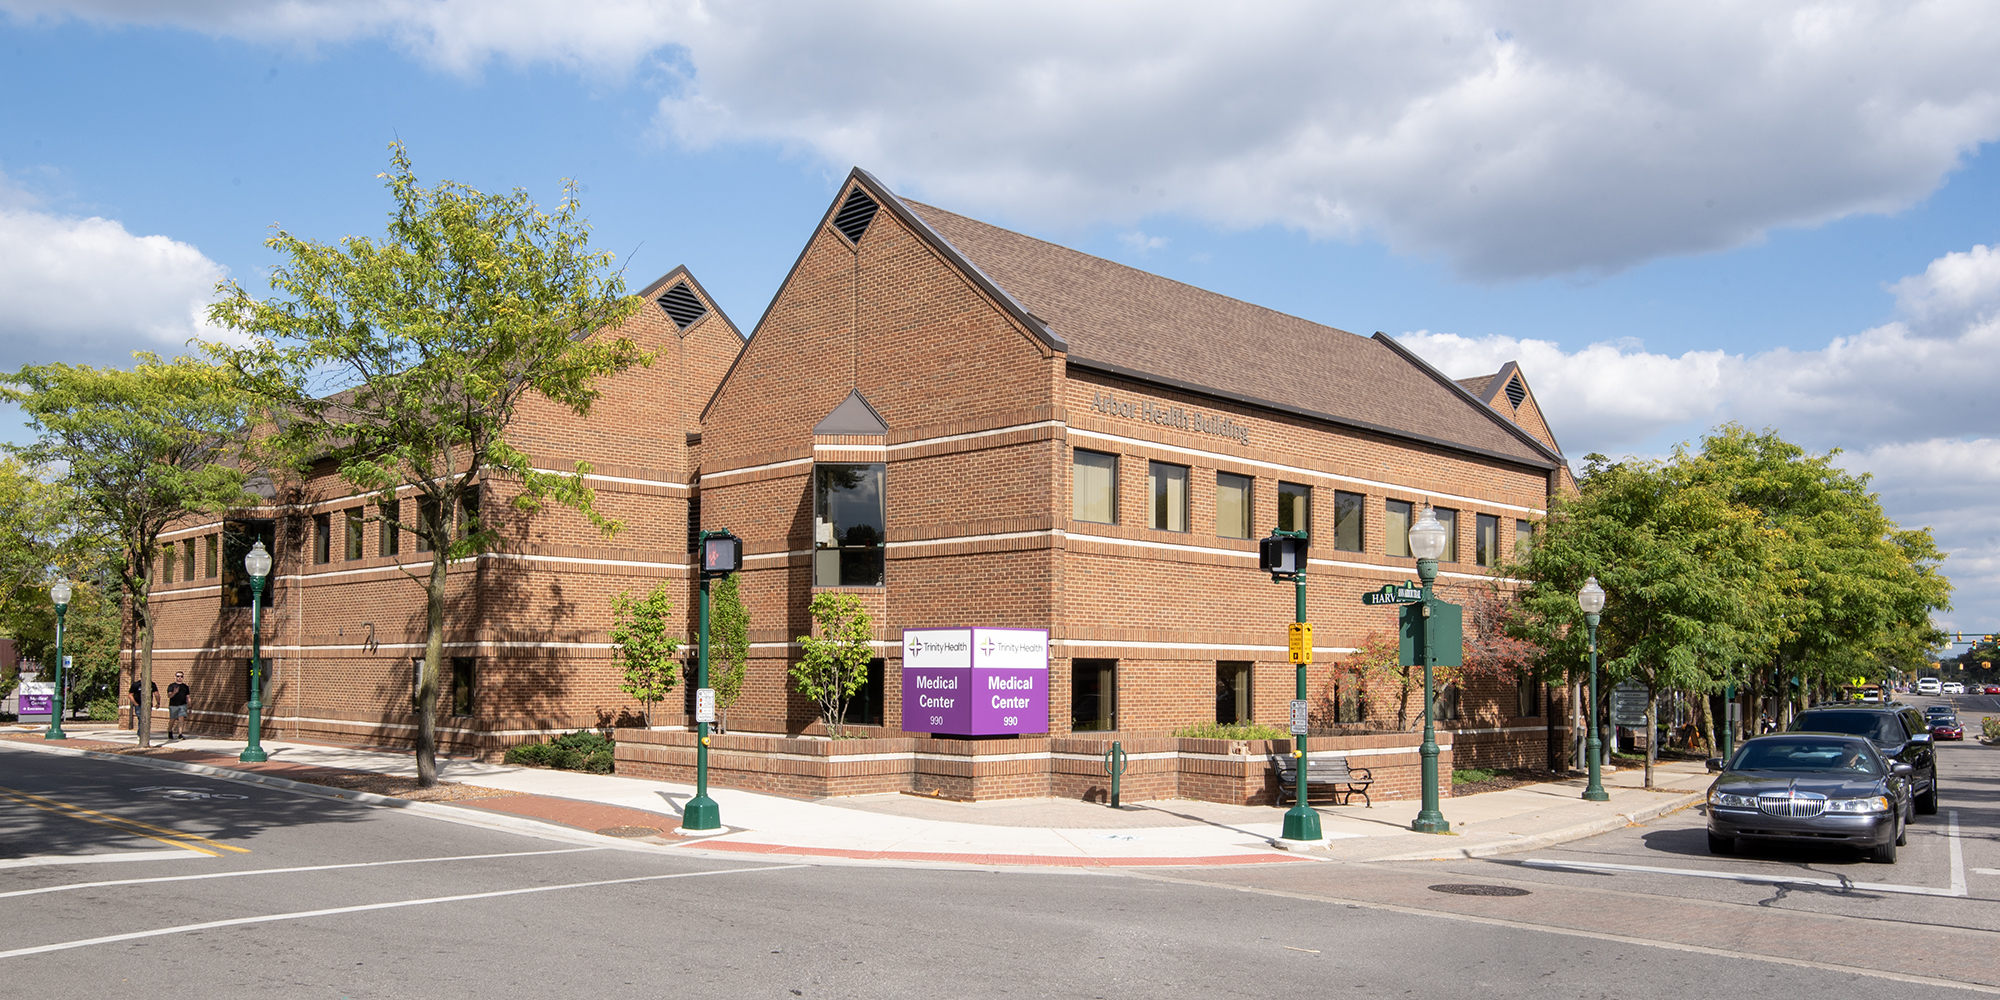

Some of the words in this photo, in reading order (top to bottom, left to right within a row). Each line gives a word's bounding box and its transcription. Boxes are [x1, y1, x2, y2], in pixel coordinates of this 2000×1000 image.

[1090, 391, 1137, 418] Arbor
[1141, 400, 1190, 430] Health
[1194, 412, 1250, 446] Building
[1372, 593, 1405, 603] HARV
[923, 642, 944, 653] Trinity
[944, 642, 967, 652] Health
[998, 642, 1019, 654] Trinity
[1019, 643, 1043, 653] Health
[916, 675, 958, 689] Medical
[988, 676, 1033, 690] Medical
[919, 694, 955, 708] Center
[991, 695, 1030, 709] Center
[930, 716, 943, 726] 990
[1003, 716, 1018, 726] 990
